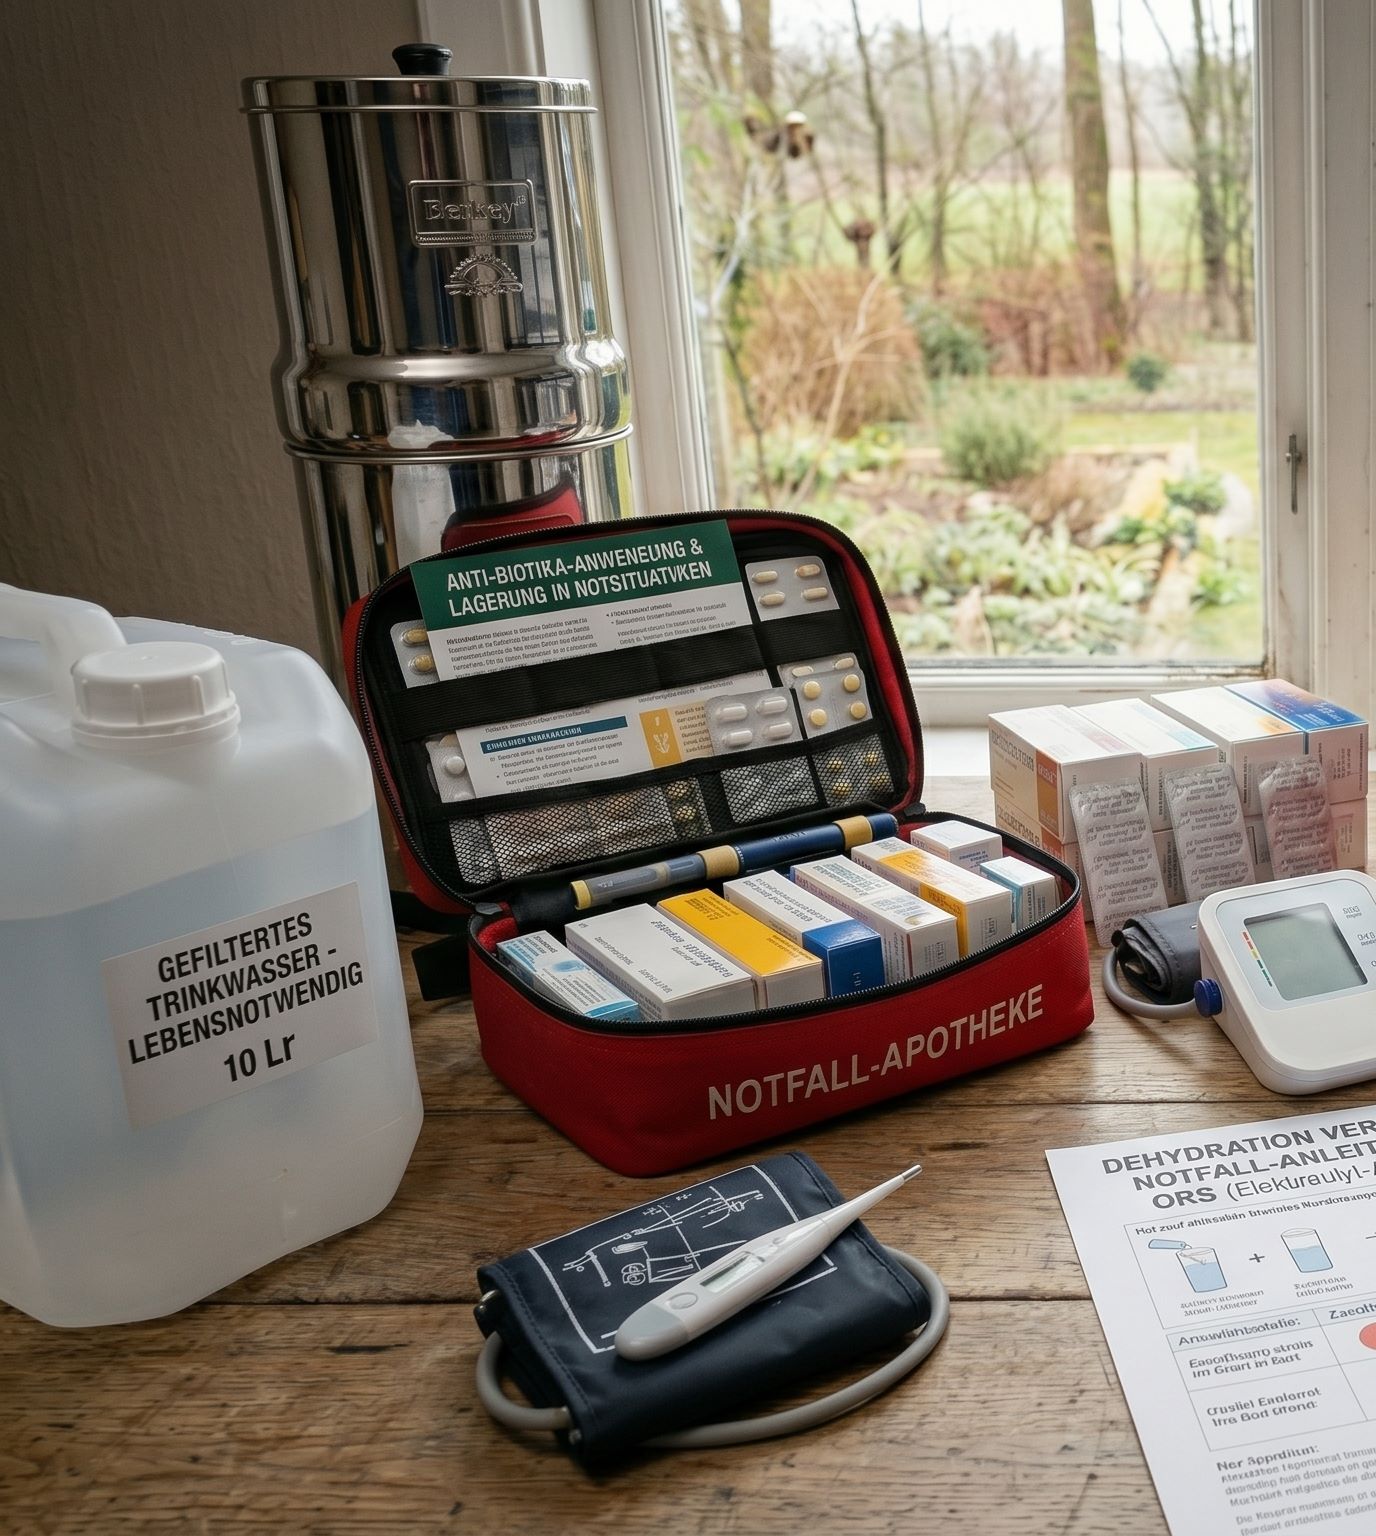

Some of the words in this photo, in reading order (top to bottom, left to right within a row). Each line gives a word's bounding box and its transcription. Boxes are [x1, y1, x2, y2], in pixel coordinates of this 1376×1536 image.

[690, 538, 703, 555] &
[448, 585, 547, 617] LAGERUNG
[552, 582, 571, 602] IN
[157, 911, 313, 983] GEFILTERTES
[146, 943, 321, 1022] TRINKWASSER
[128, 961, 364, 1065] LEBENSNOTWENDIG
[223, 1048, 257, 1082] 10
[263, 1033, 296, 1068] Lr
[707, 983, 1043, 1121] NOTFALL-APOTHEKE
[1101, 1129, 1315, 1175] DEHYDRATION
[1151, 1187, 1217, 1210] ORS
